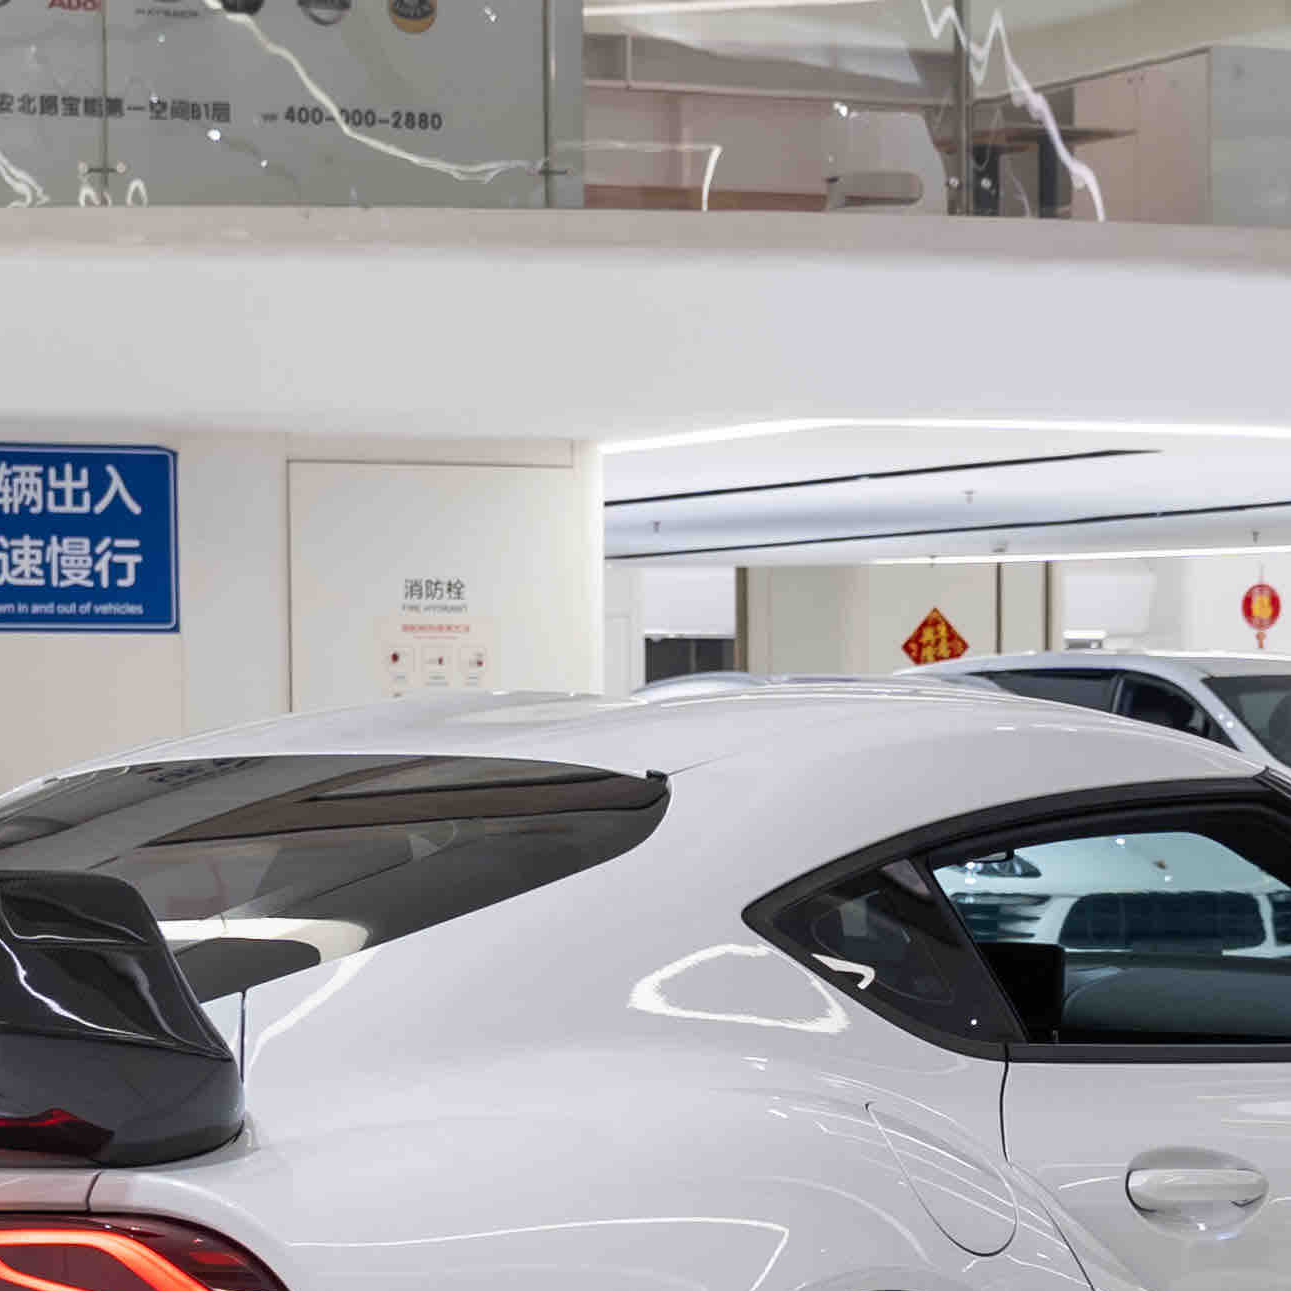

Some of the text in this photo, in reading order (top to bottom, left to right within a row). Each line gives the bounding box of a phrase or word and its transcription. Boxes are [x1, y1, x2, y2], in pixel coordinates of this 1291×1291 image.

[405, 578, 465, 600] 消防栓
[17, 602, 29, 615] in
[31, 602, 55, 615] and
[56, 602, 77, 615] out
[78, 601, 93, 615] of
[93, 602, 144, 616] vehicles
